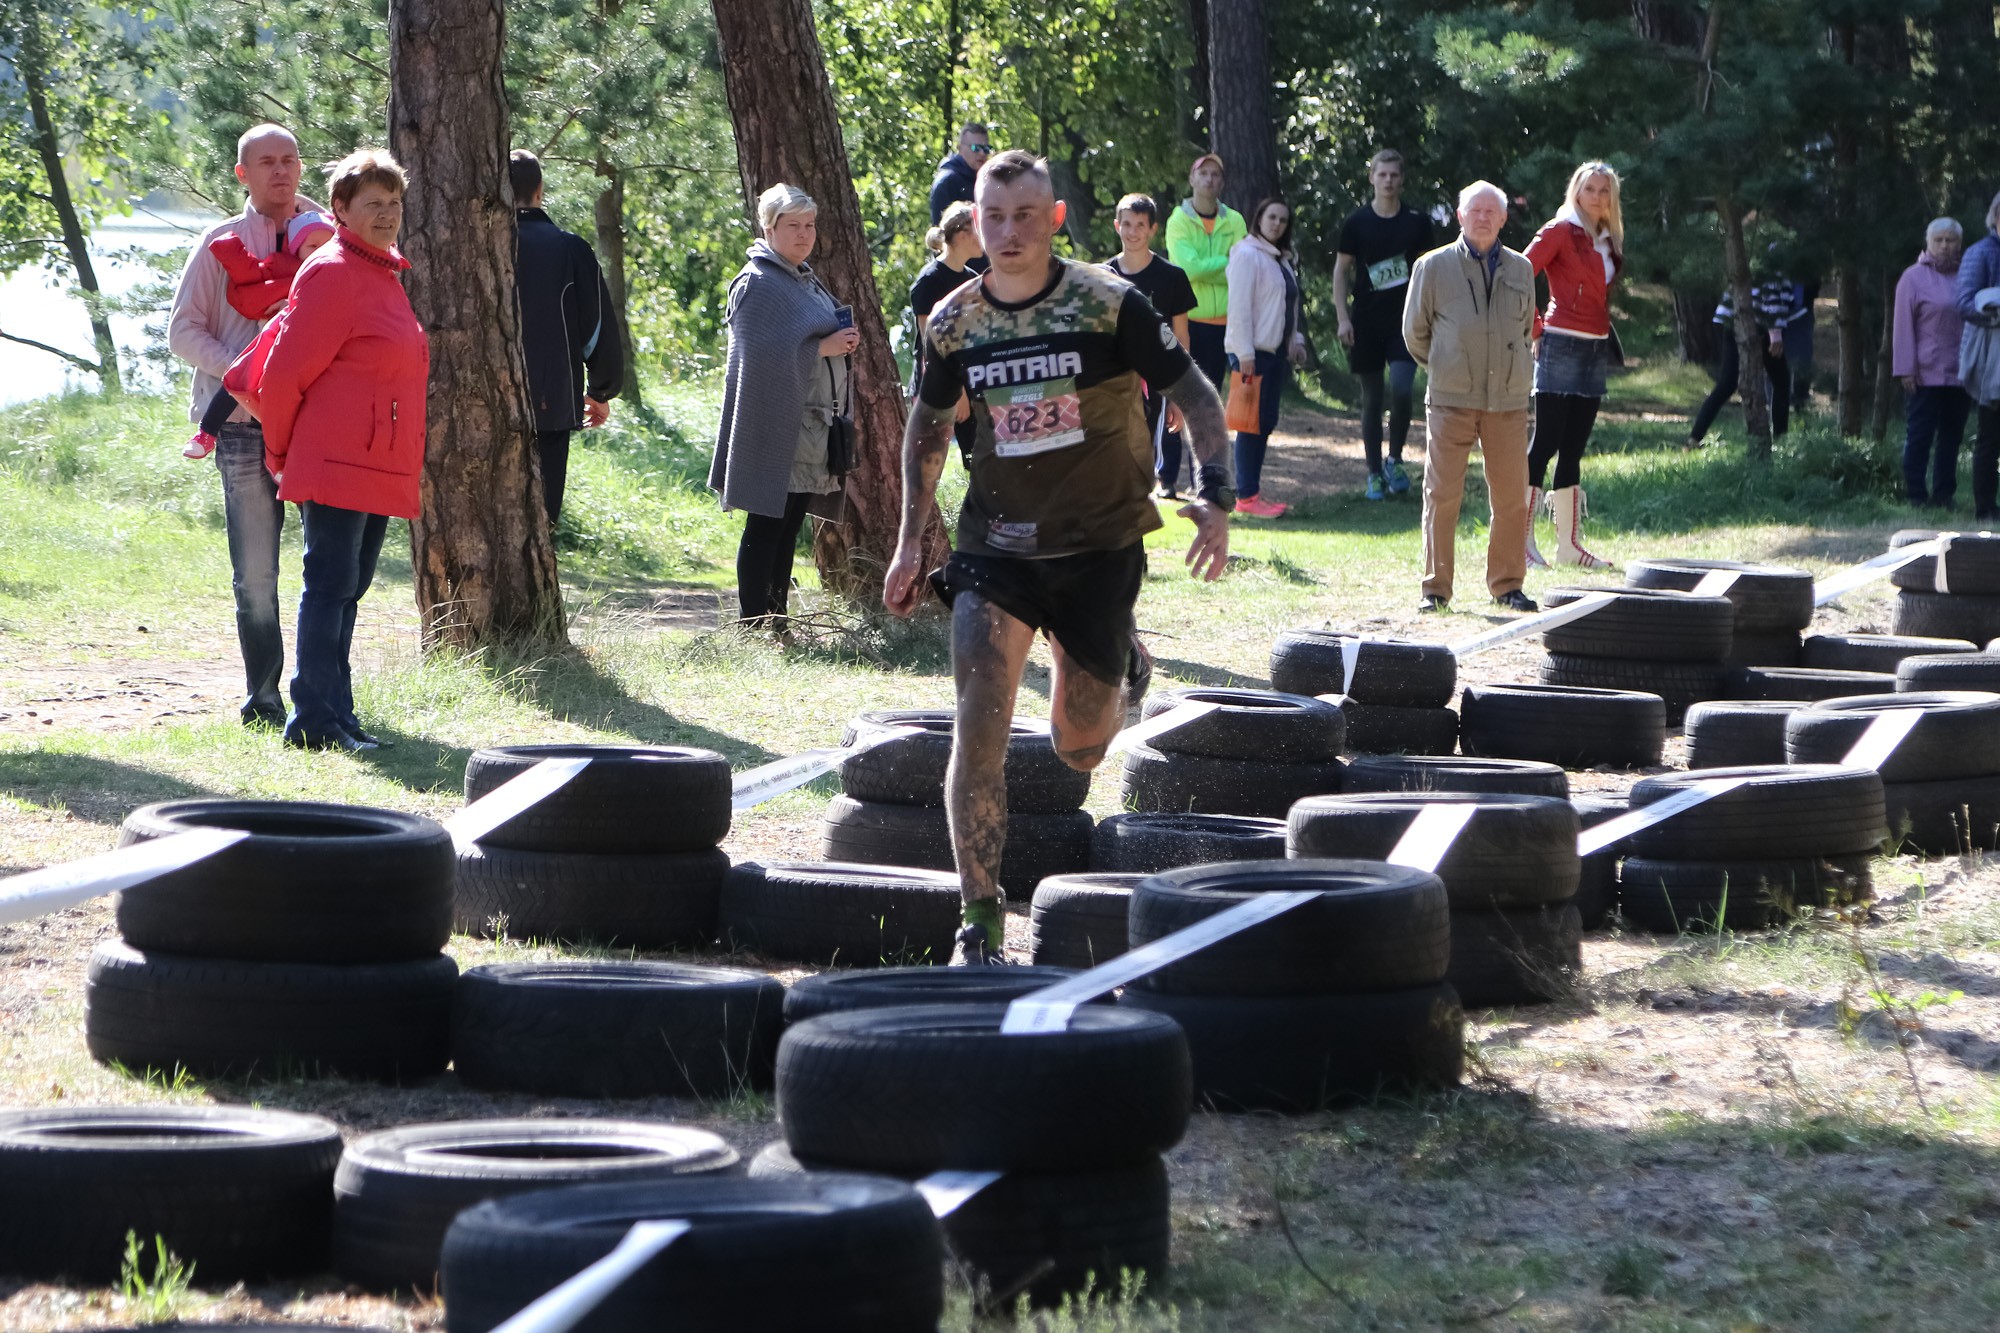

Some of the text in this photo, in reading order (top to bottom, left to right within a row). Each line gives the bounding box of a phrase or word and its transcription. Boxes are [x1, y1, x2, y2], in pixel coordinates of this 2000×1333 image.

[991, 344, 1049, 357] www.patriateam.lv
[967, 351, 1082, 389] PATRIA
[1011, 392, 1044, 404] MEZGLS
[1008, 401, 1060, 434] 623
